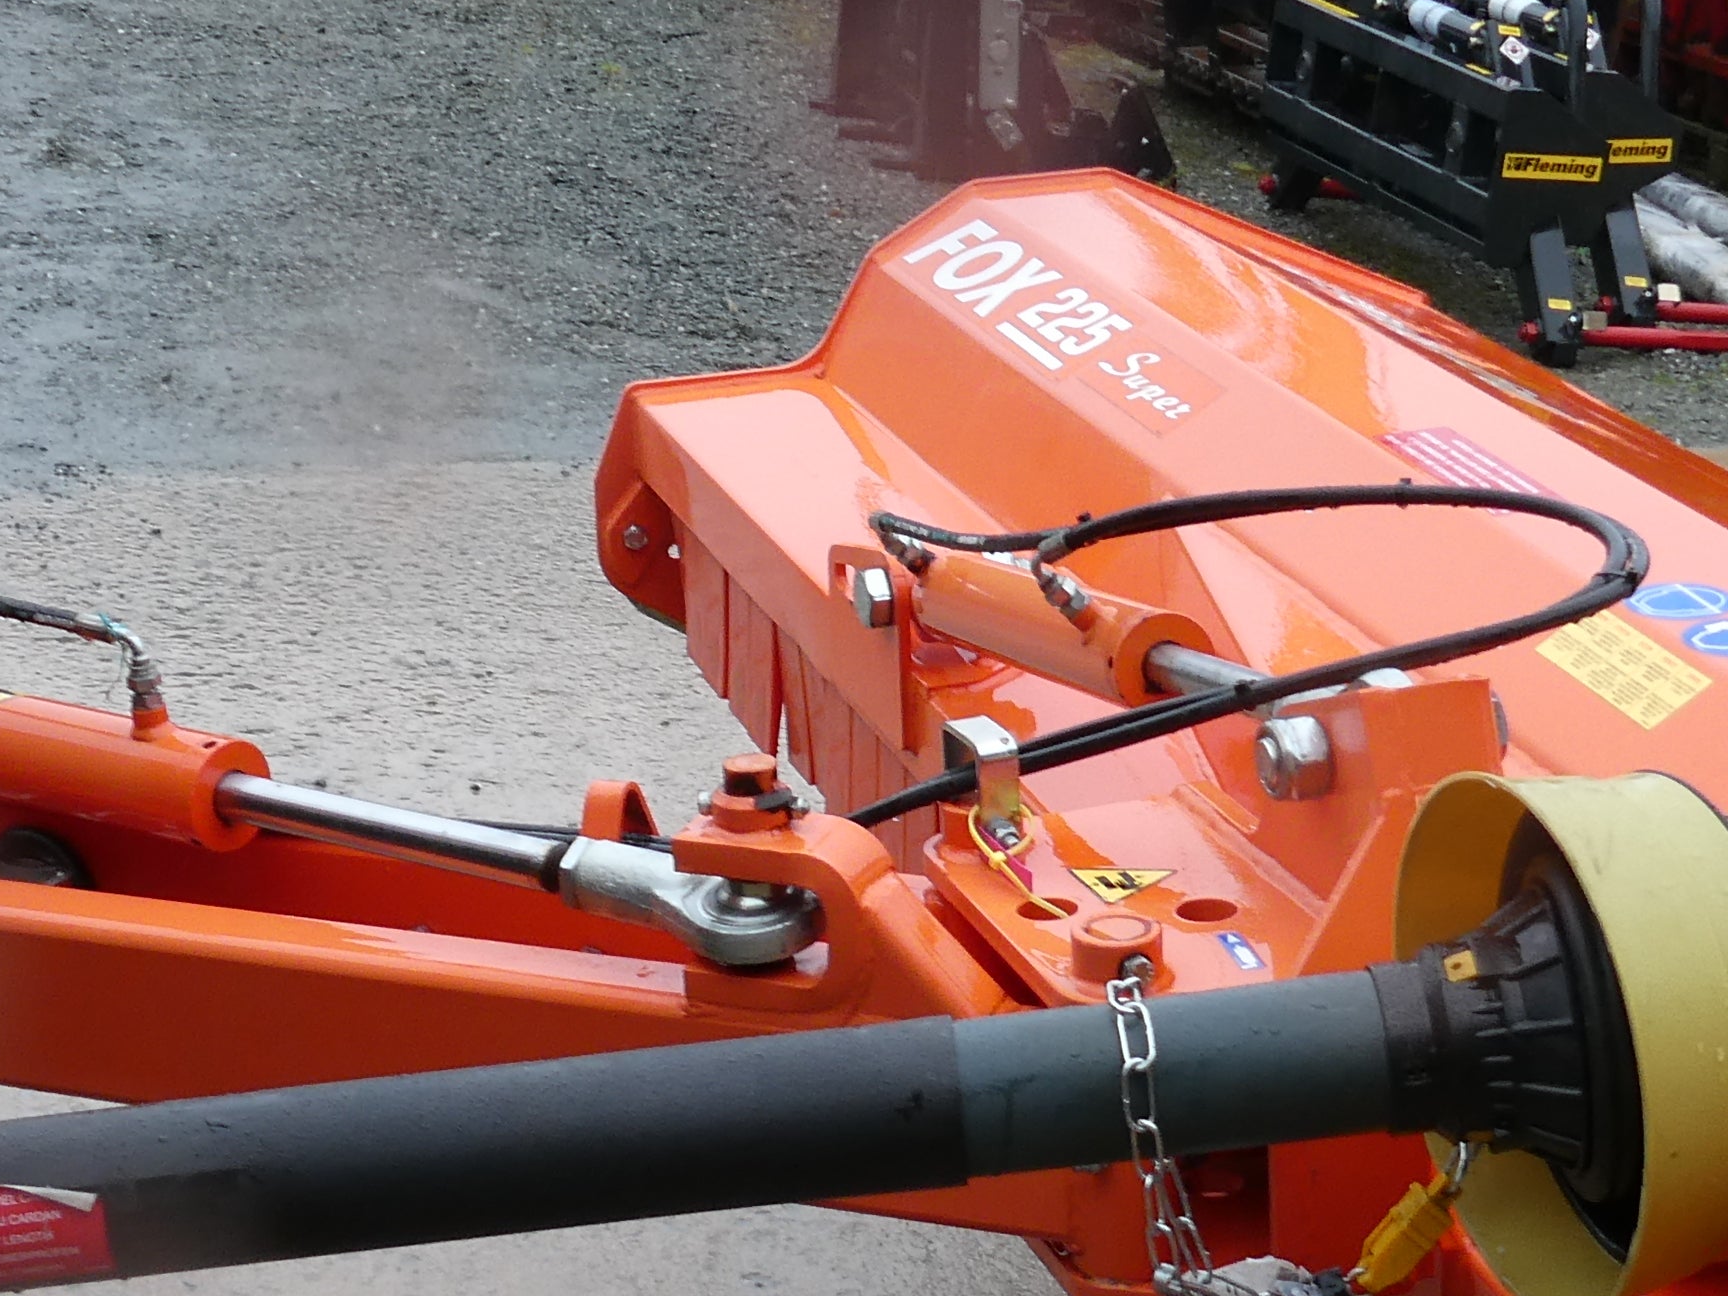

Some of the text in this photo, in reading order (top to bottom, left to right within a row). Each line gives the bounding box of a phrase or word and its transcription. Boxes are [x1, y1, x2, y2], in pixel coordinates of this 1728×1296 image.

[1526, 157, 1598, 179] Fleming
[902, 218, 1193, 420] FOX 225 Super
